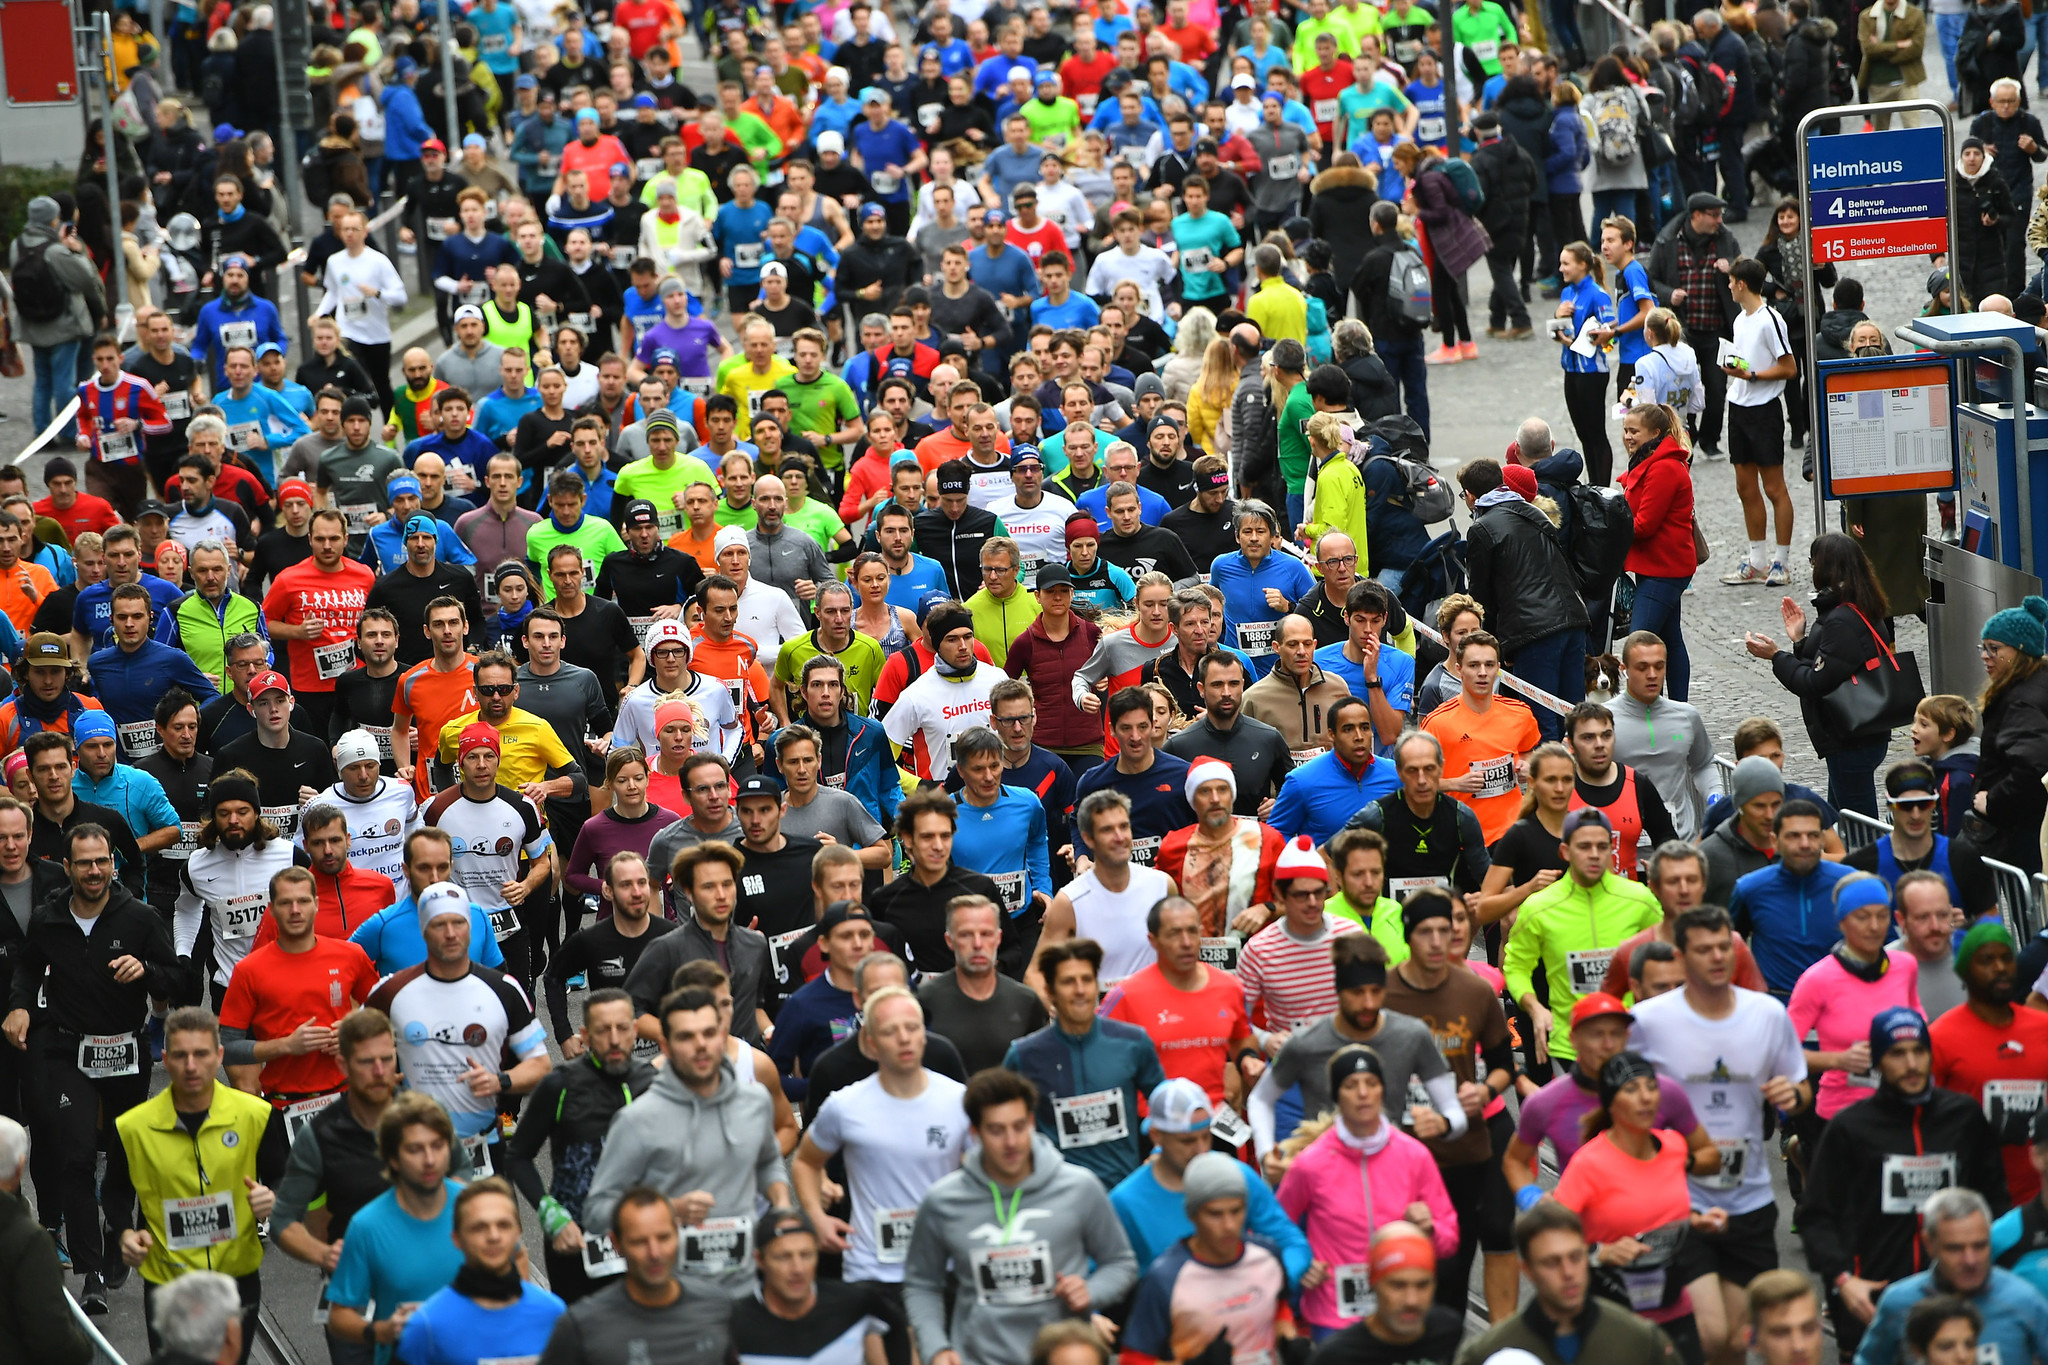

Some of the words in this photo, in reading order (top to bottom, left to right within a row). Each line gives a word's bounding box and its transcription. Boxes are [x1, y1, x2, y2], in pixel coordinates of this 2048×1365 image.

[1812, 159, 1903, 179] Helmhaus
[1828, 197, 1846, 219] 4
[1848, 198, 1885, 208] Bellevue
[1849, 209, 1866, 218] Bhf.
[1867, 204, 1928, 216] Tiefenbrunnen
[1850, 236, 1886, 246] Bellevue
[1822, 239, 1845, 259] 15
[1850, 246, 1885, 257] Bahnhof
[1887, 242, 1937, 254] Stadelhofen
[942, 481, 962, 489] GORE
[1004, 523, 1050, 535] Sunrise
[302, 610, 363, 619] LAUSANN
[1245, 631, 1272, 642] 18865
[323, 643, 347, 653] MIGROS
[1251, 641, 1266, 649] RETO
[325, 650, 350, 663] 16234
[331, 660, 349, 670] JONAS
[942, 699, 991, 720] Sunrise
[126, 722, 153, 731] MIGROS
[365, 726, 391, 734] MIGROS
[128, 730, 155, 743] 13467
[132, 739, 156, 749] MORITZ
[1291, 750, 1316, 758] MIGROS
[1481, 756, 1508, 768] MIGROS
[1484, 765, 1509, 780] 19133
[827, 775, 842, 784] ROS
[1484, 777, 1509, 789] THOMAS
[266, 816, 291, 826] 7025
[346, 842, 401, 858] rackpartner
[1403, 878, 1435, 886] MIGROS
[996, 883, 1016, 895] 794
[782, 930, 807, 942] MIGR
[1201, 938, 1226, 946] IGROS
[1200, 949, 1229, 961] 5288
[93, 1036, 124, 1045] MIGROS
[1161, 1038, 1210, 1050] FINISHER
[92, 1046, 127, 1059] 18629
[91, 1058, 127, 1068] CHRISTIAN
[297, 1098, 333, 1112] MIGROS
[177, 1197, 216, 1209] MIGROS
[180, 1210, 219, 1226] 19574
[183, 1222, 219, 1237] HANNES
